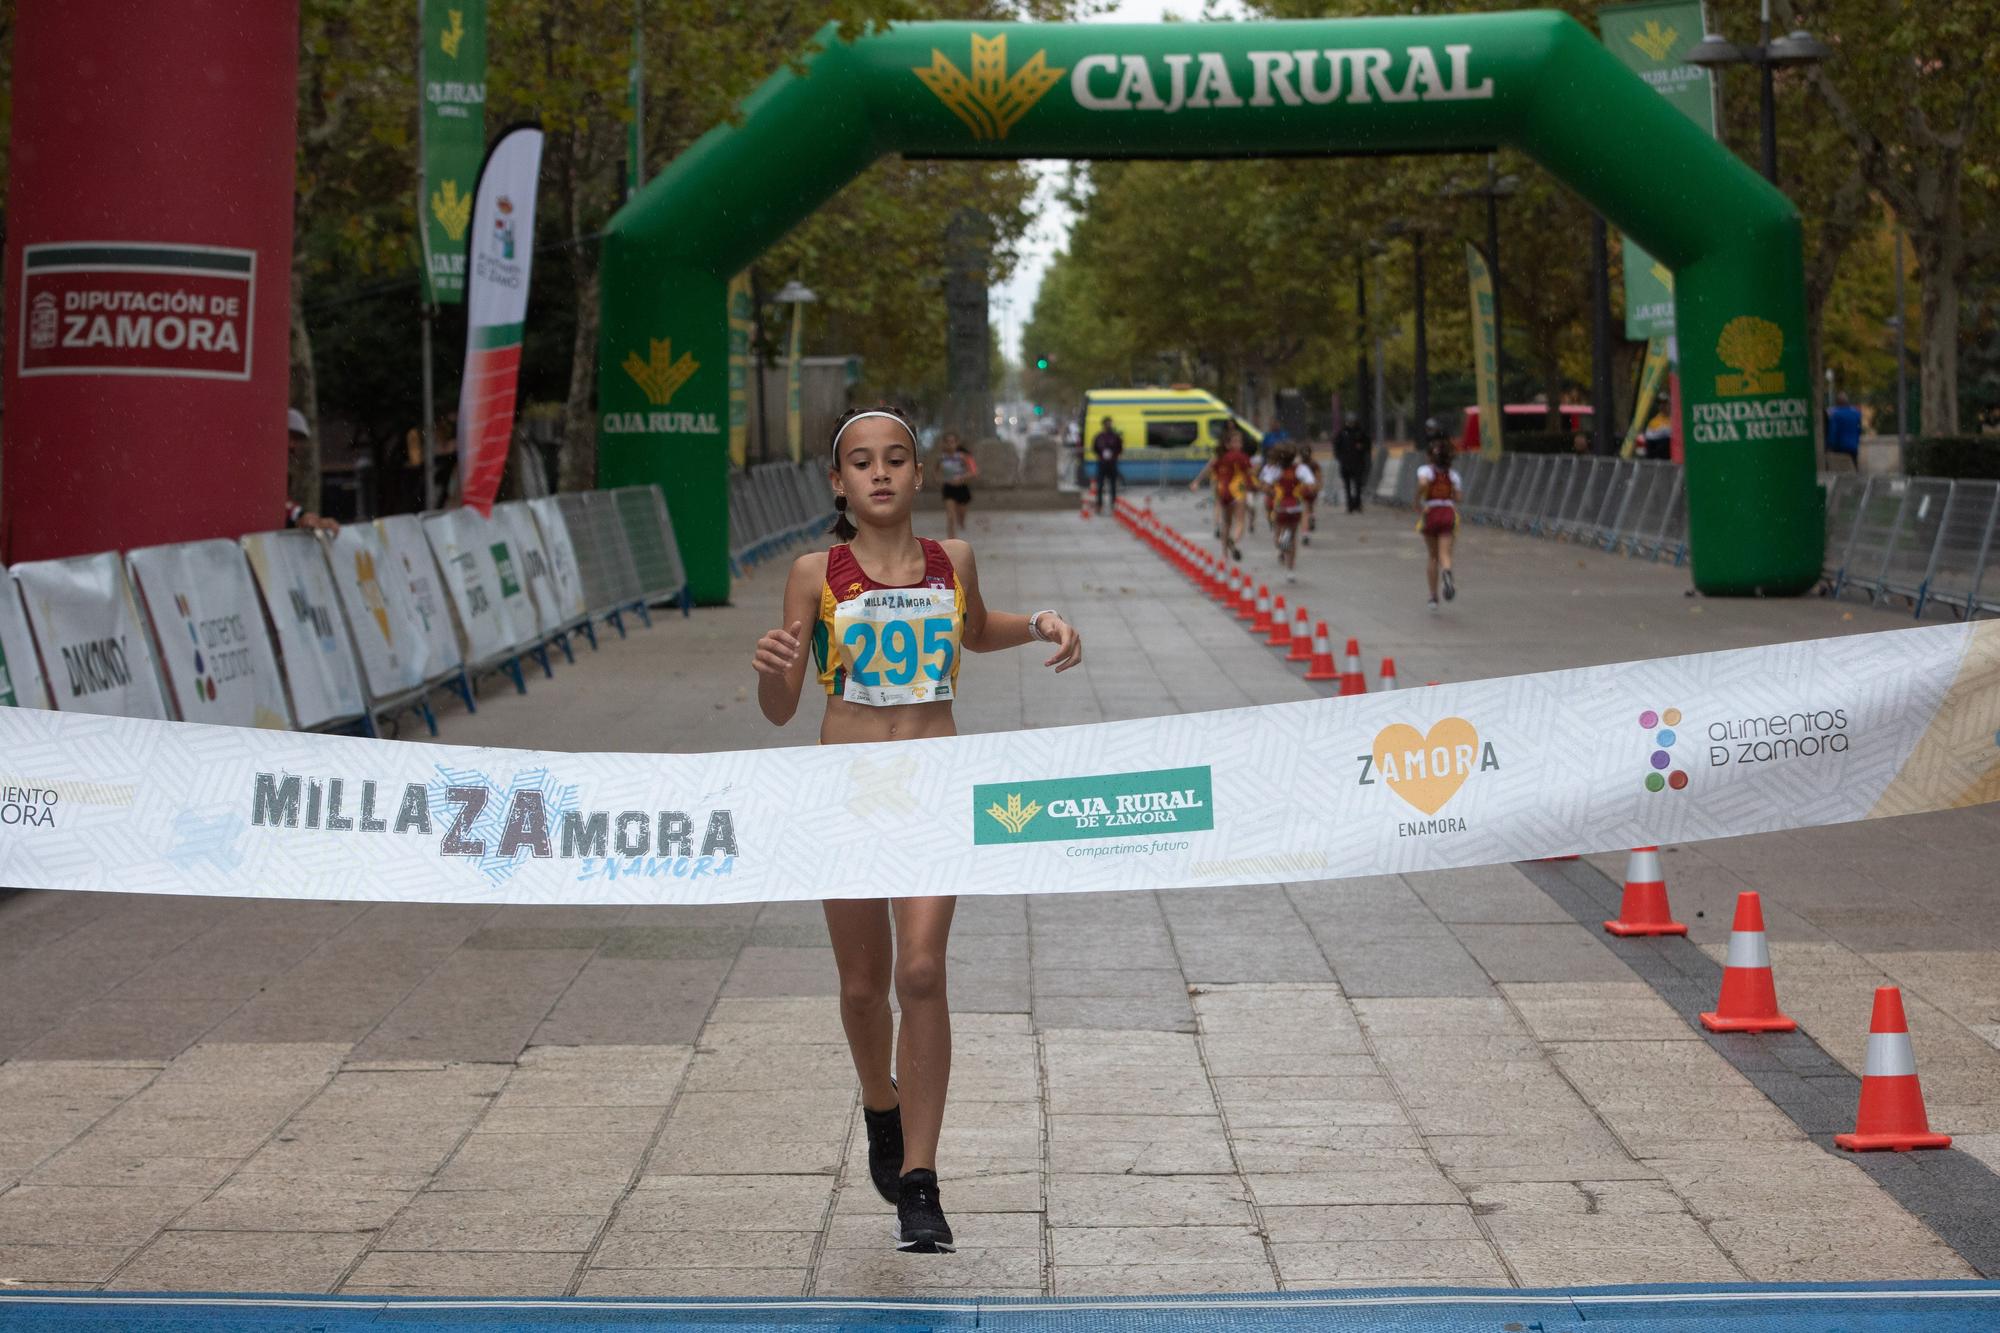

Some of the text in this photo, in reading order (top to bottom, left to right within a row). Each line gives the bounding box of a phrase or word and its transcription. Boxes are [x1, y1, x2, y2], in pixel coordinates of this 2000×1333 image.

[1070, 44, 1494, 113] CAJA RURAL
[65, 289, 240, 317] DIPUTACIÓN DE
[61, 315, 240, 353] ZAMORA
[648, 411, 720, 434] RURAL
[1693, 418, 1809, 442] CAJA RURAL
[843, 618, 954, 687] 295
[1737, 733, 1849, 764] zamora
[1357, 741, 1500, 786] ZAMORA
[1, 786, 58, 806] IENTO
[1047, 789, 1204, 818] CAJA RURAL
[0, 803, 56, 828] ORA
[1076, 810, 1178, 829] DE ZAMORA
[1398, 816, 1467, 838] ENAMORA
[1066, 839, 1190, 859] Compartimos futuro
